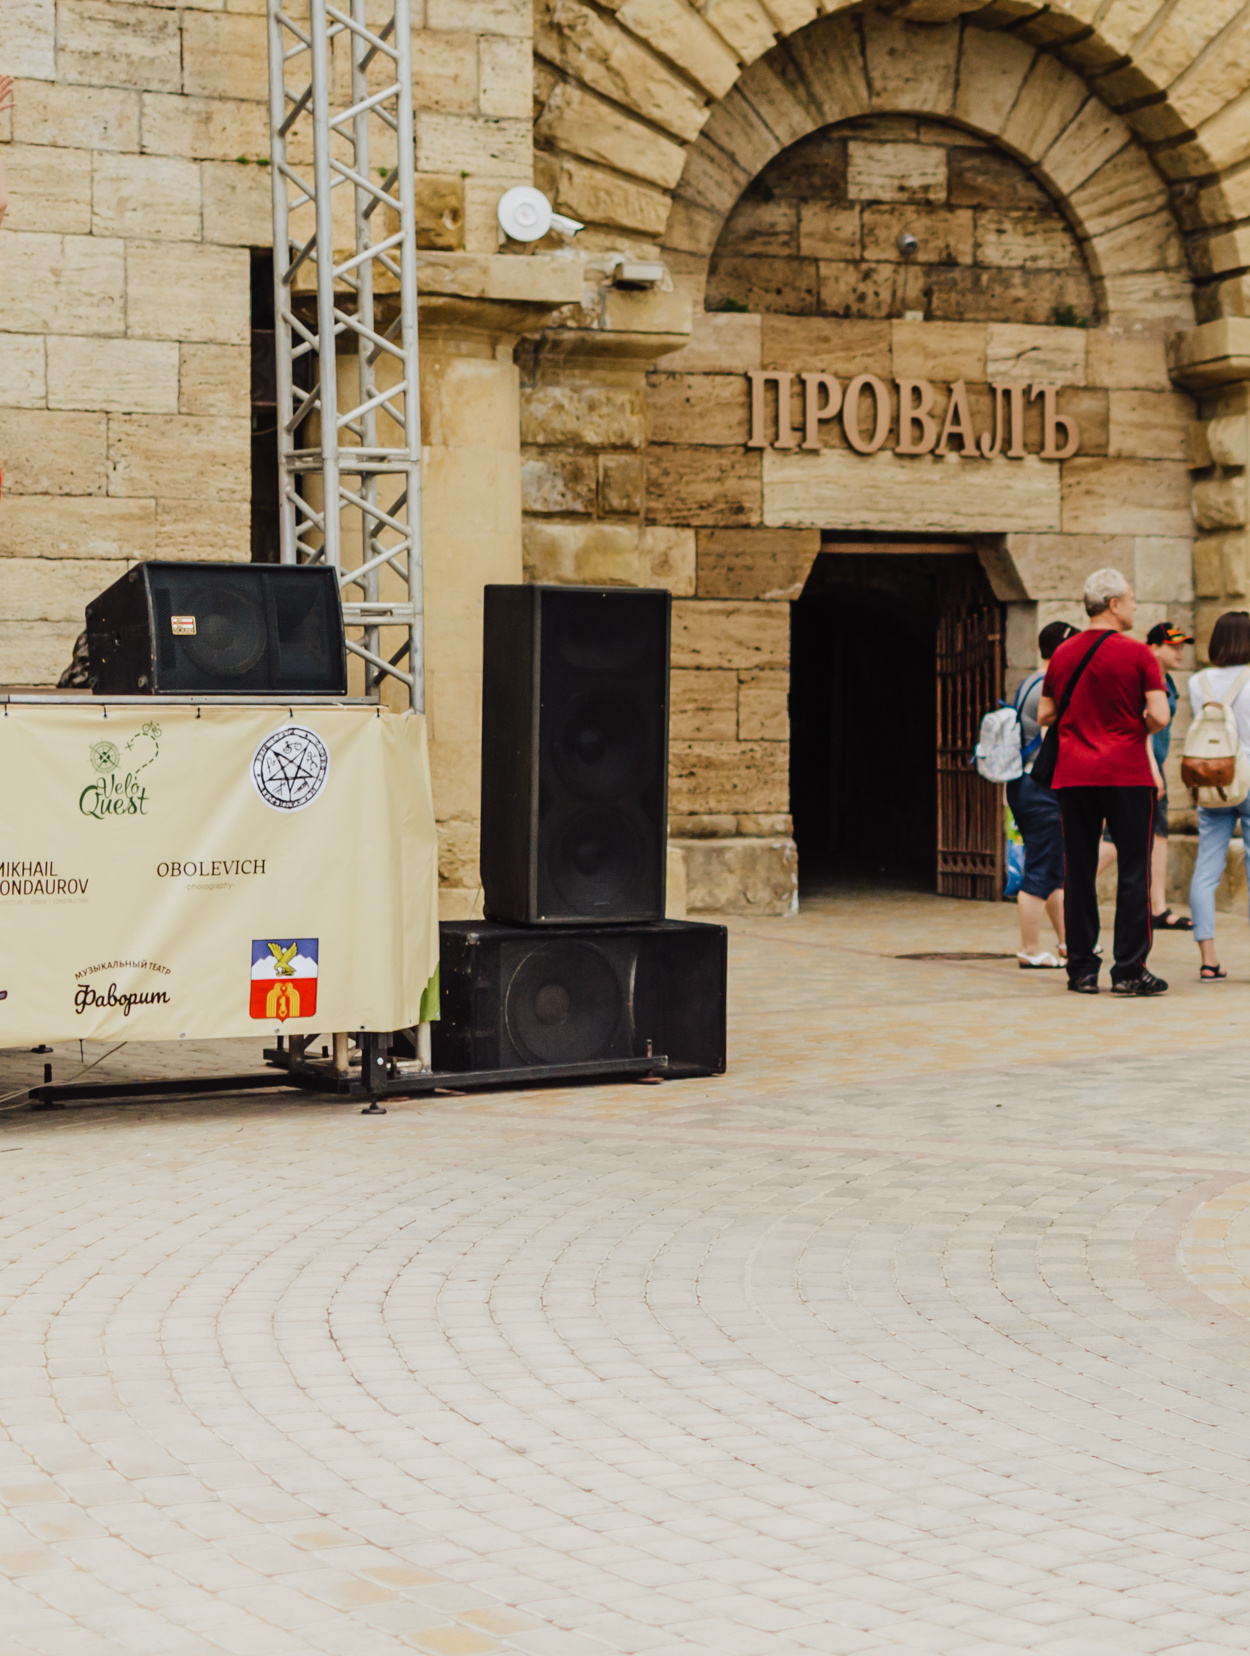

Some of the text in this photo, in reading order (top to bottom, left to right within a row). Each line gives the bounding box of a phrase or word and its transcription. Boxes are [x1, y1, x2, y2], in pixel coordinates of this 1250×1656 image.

[747, 371, 1080, 459] ПРОВАЛЪ
[97, 772, 140, 799] Velo
[79, 785, 149, 820] Quest
[156, 859, 266, 877] OBOLEVICH
[75, 960, 172, 980] МУЗЫКАЛЬНЫЙ ТЕАТР
[74, 982, 170, 1017] Фаворит
